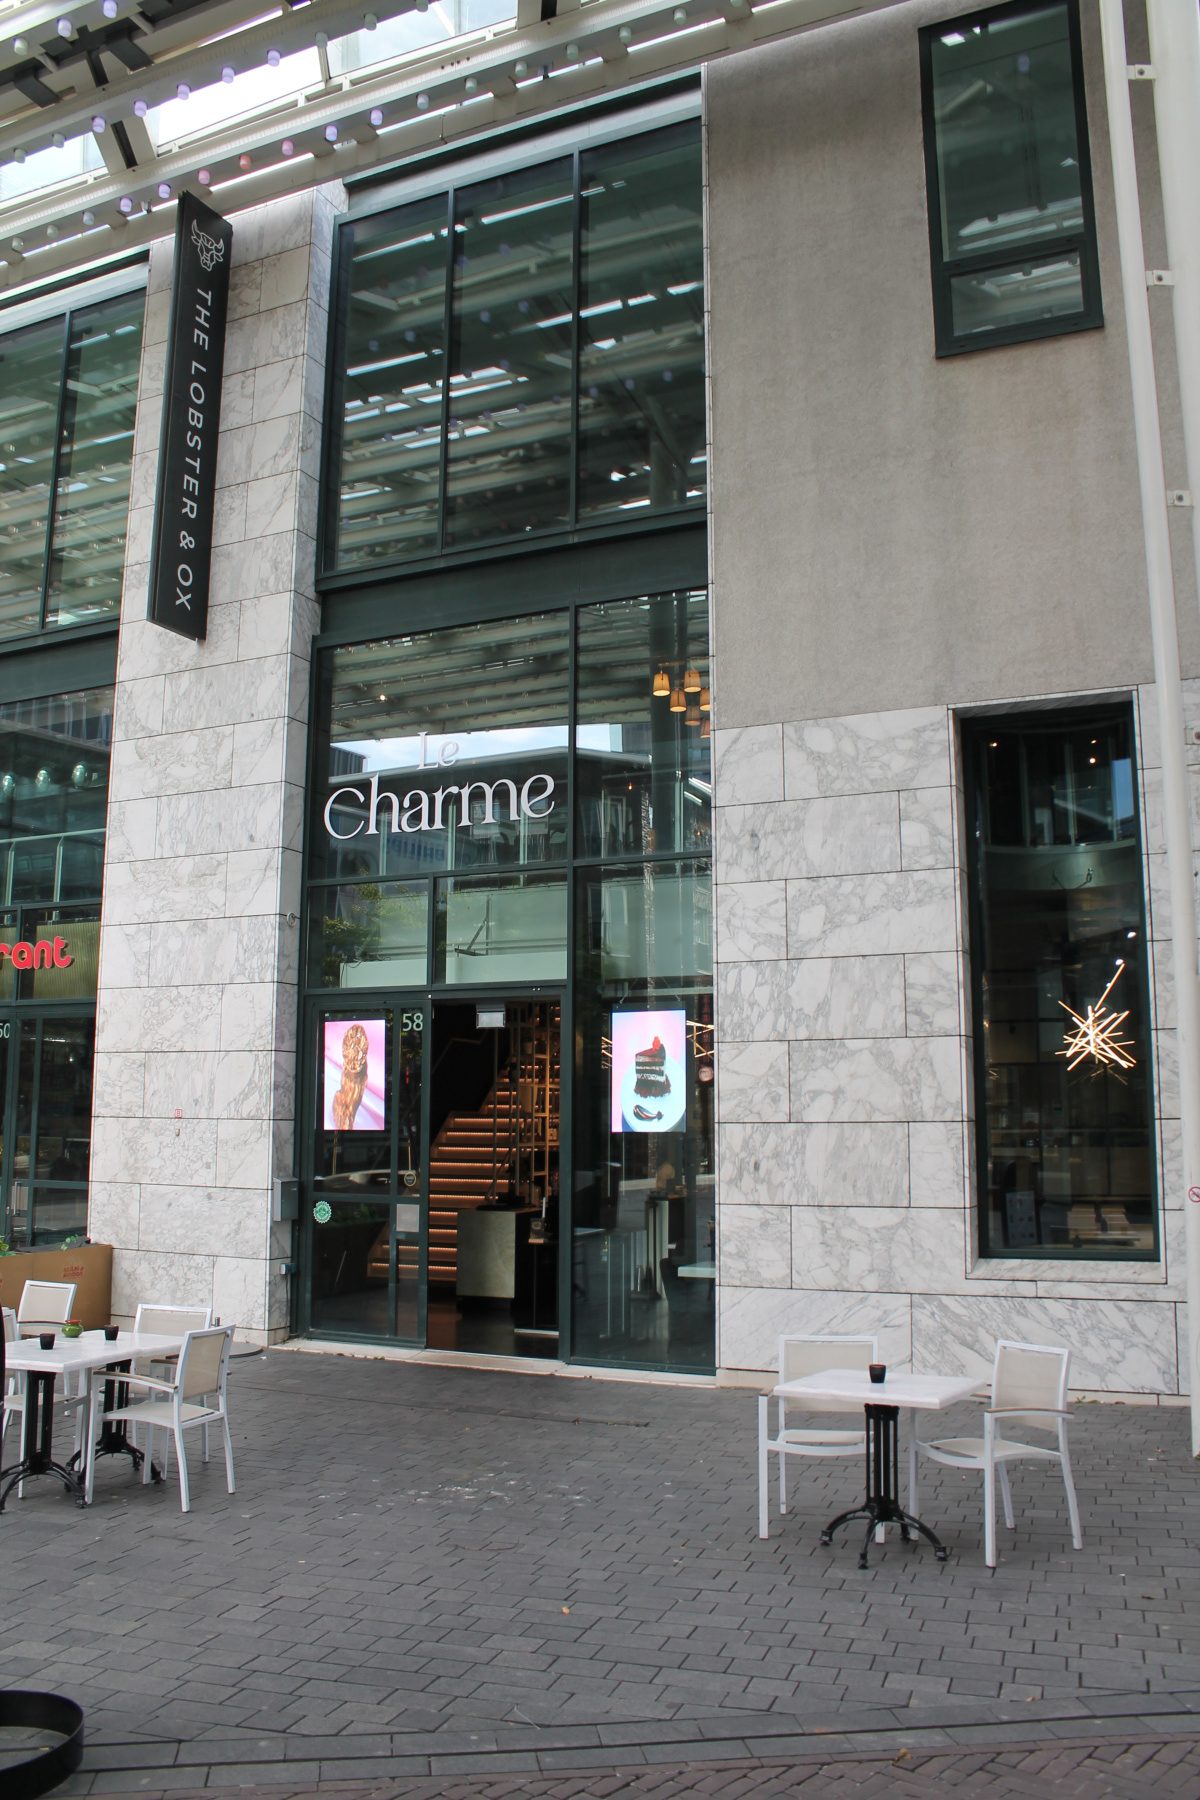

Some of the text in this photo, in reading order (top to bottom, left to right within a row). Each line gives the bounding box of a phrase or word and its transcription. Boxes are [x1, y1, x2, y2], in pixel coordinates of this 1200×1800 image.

[175, 287, 212, 611] THE LOBSTER & OX
[416, 731, 460, 770] Le
[323, 772, 555, 840] Charme
[402, 1012, 424, 1032] 58
